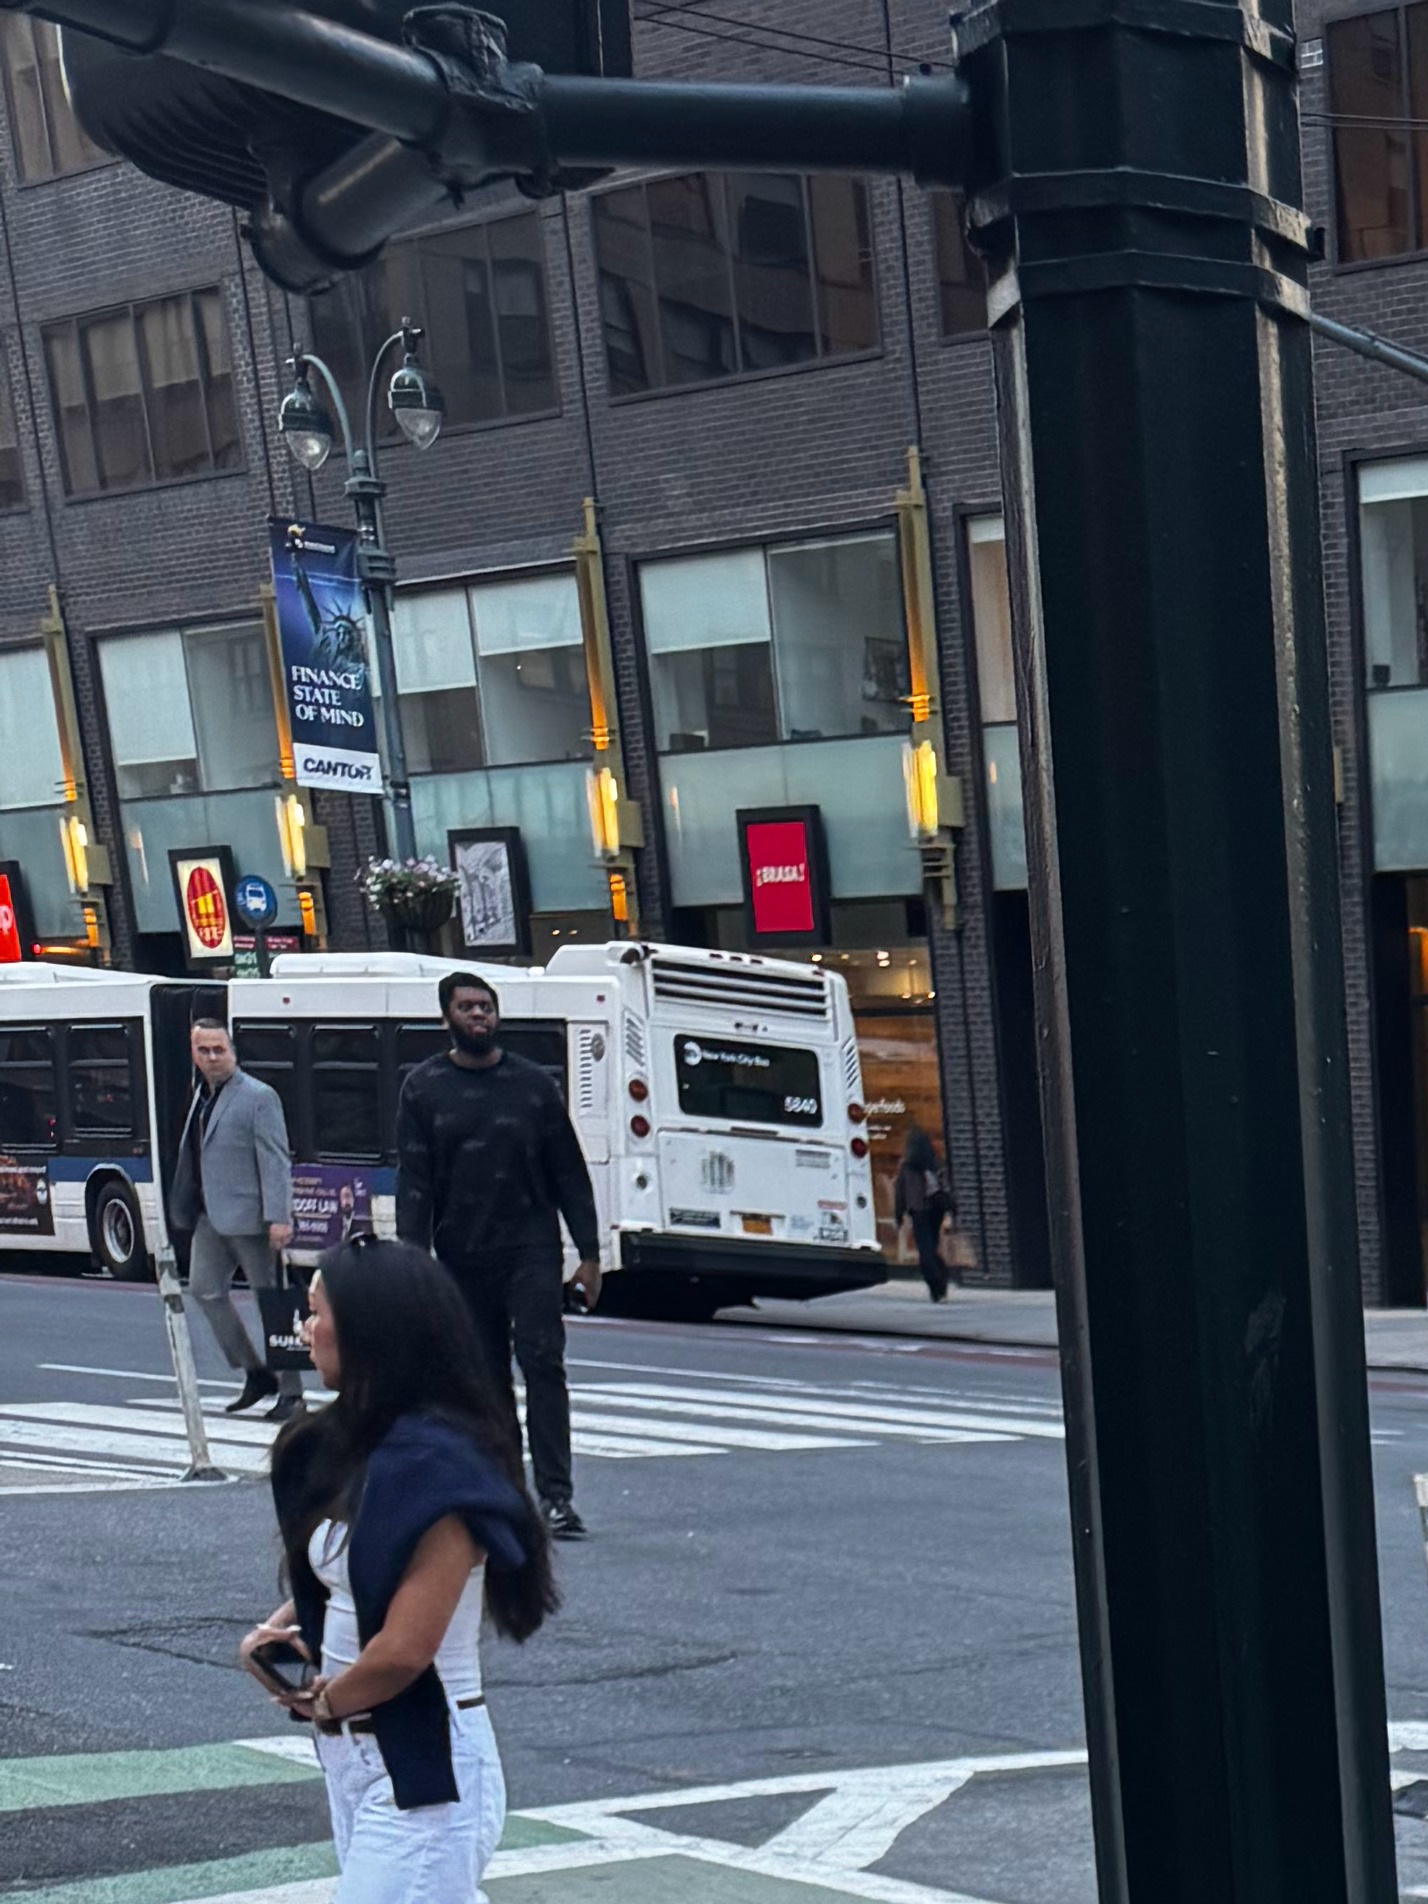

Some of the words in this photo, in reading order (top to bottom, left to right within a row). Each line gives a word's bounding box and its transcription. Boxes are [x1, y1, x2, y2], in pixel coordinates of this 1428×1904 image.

[291, 664, 362, 690] FINANCE
[293, 685, 342, 706] STATE
[295, 703, 318, 721] OF
[320, 707, 364, 728] MIND
[302, 757, 374, 781] CANTOR
